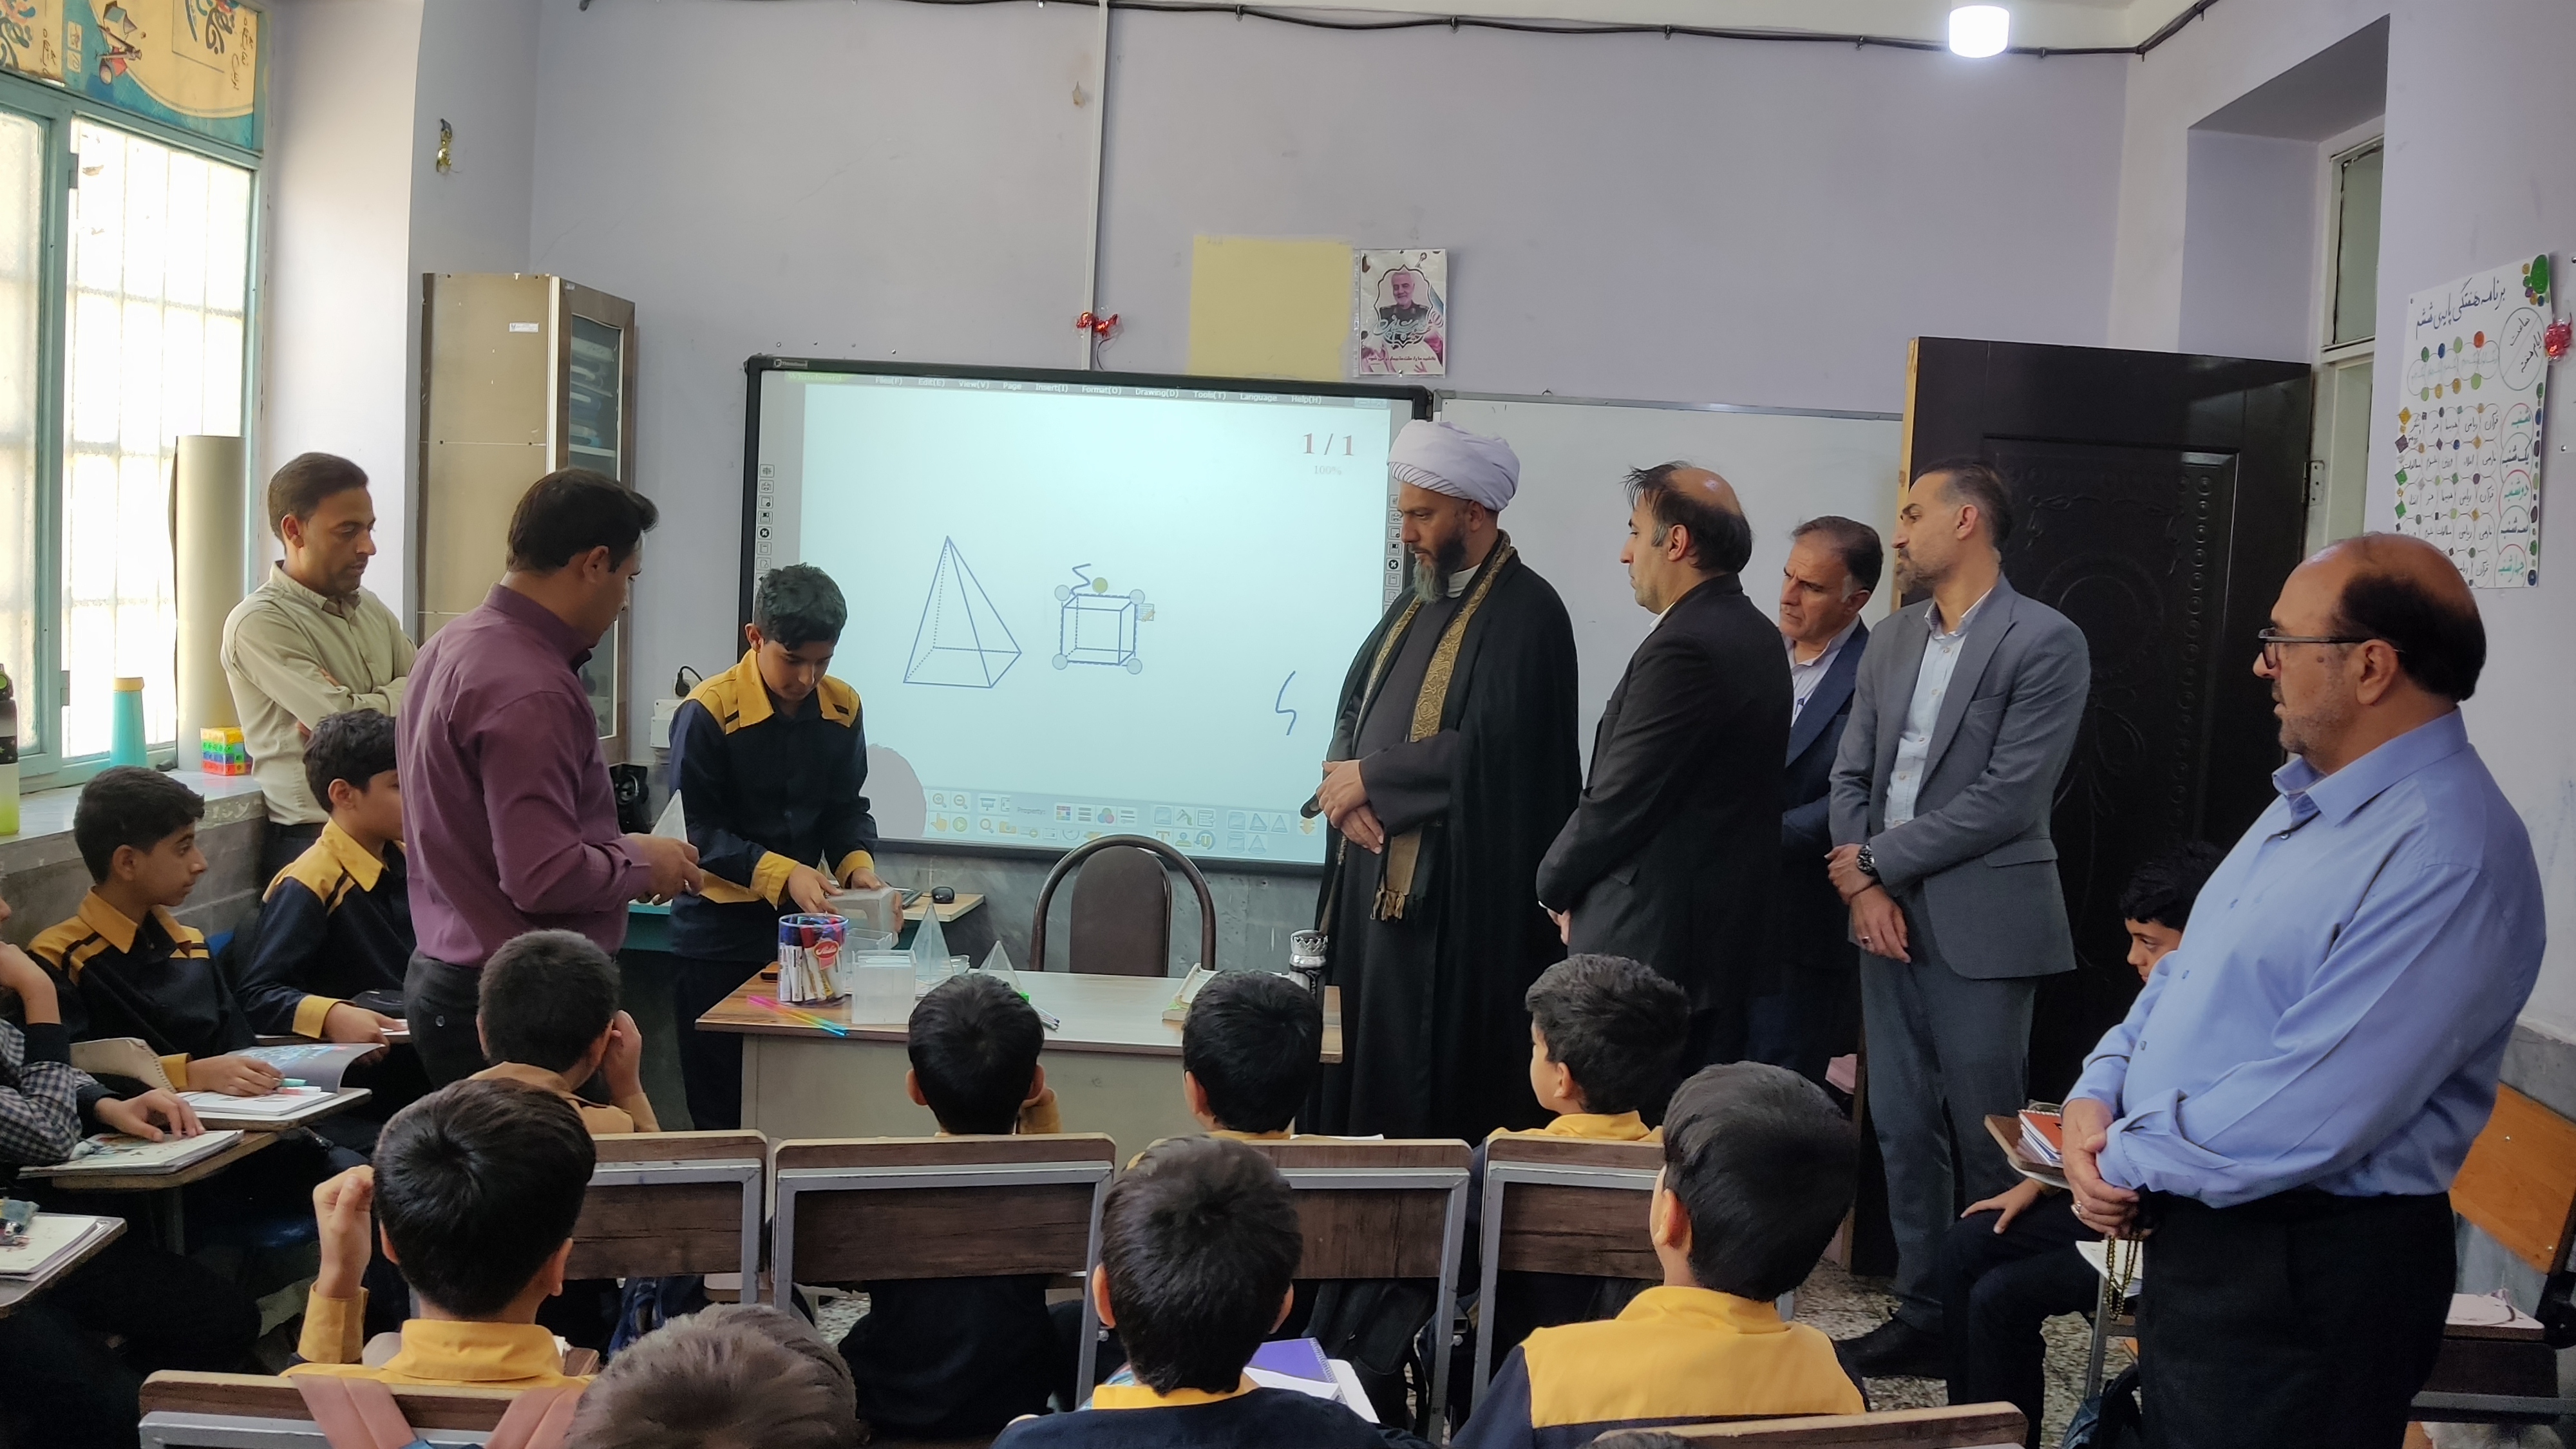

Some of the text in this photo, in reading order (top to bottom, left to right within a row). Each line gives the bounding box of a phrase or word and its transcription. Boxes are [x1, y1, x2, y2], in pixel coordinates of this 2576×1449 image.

[2452, 277, 2481, 321] هفتگی
[2481, 276, 2506, 310] برنامه
[2416, 301, 2433, 339] ششم
[2510, 317, 2530, 346] ساعت
[959, 381, 990, 390] View(V)
[1003, 382, 1022, 390] Page
[1036, 383, 1068, 393] Insert(I)
[1081, 385, 1122, 395] Format(O)
[1135, 388, 1179, 399] Drawing(D)
[1193, 390, 1226, 401] Tools(T)
[1240, 393, 1278, 403] Language
[1291, 395, 1322, 405] Help(H)
[2465, 417, 2477, 432] ریاضی
[2485, 410, 2499, 431] قرآن
[2511, 407, 2531, 428] شنبه
[1314, 465, 1342, 475] 100%
[2459, 488, 2472, 506] ریاضی
[2479, 485, 2494, 503] قرآن
[2459, 525, 2472, 542] ریاضی
[2476, 561, 2489, 577] قرآن
